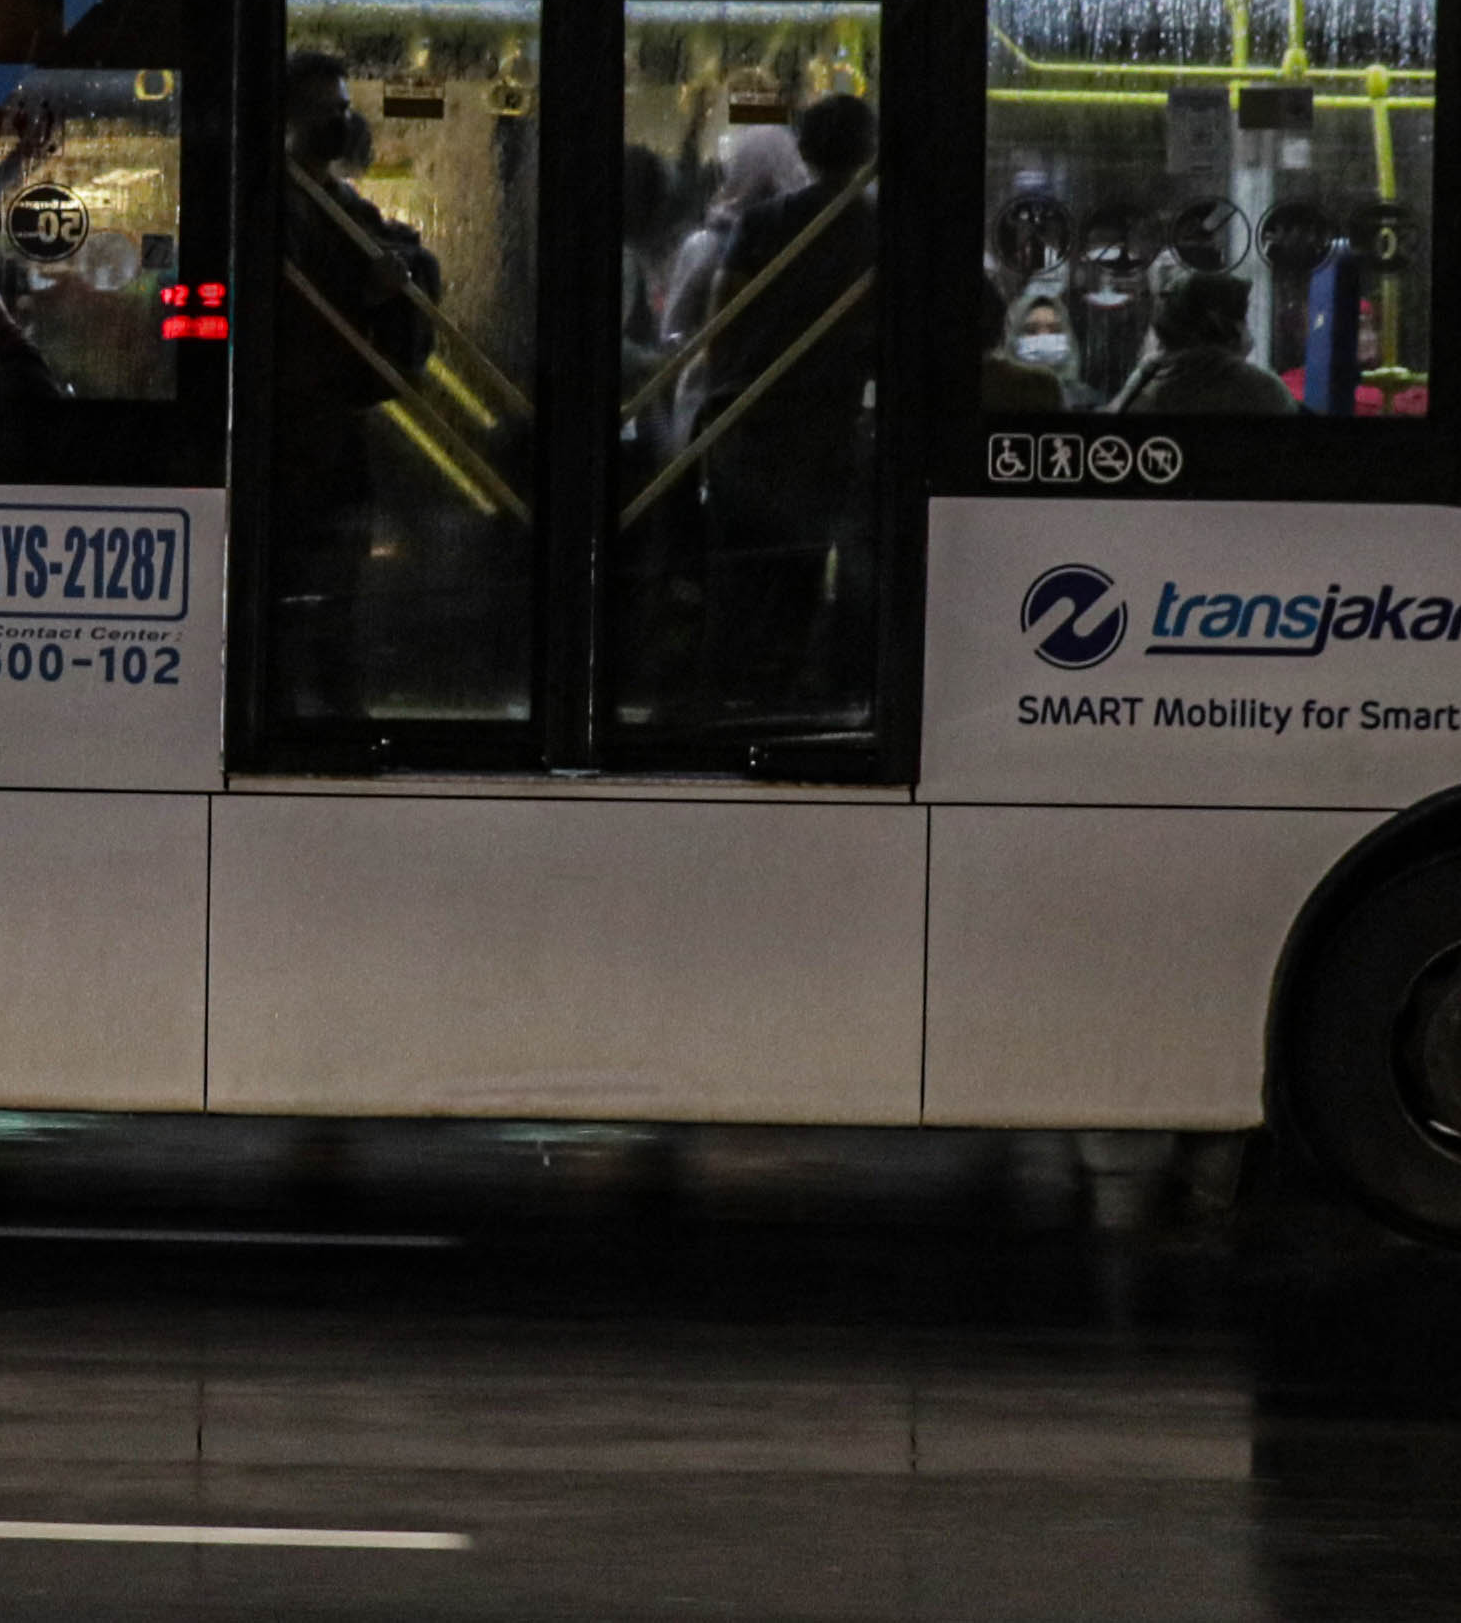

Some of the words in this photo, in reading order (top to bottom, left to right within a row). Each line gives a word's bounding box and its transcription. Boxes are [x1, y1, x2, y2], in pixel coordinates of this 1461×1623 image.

[90, 626, 170, 643] Center
[1017, 695, 1144, 726] SMART
[1153, 696, 1293, 736] Mobility
[1302, 699, 1350, 729] for
[1360, 700, 1461, 731] Smart
